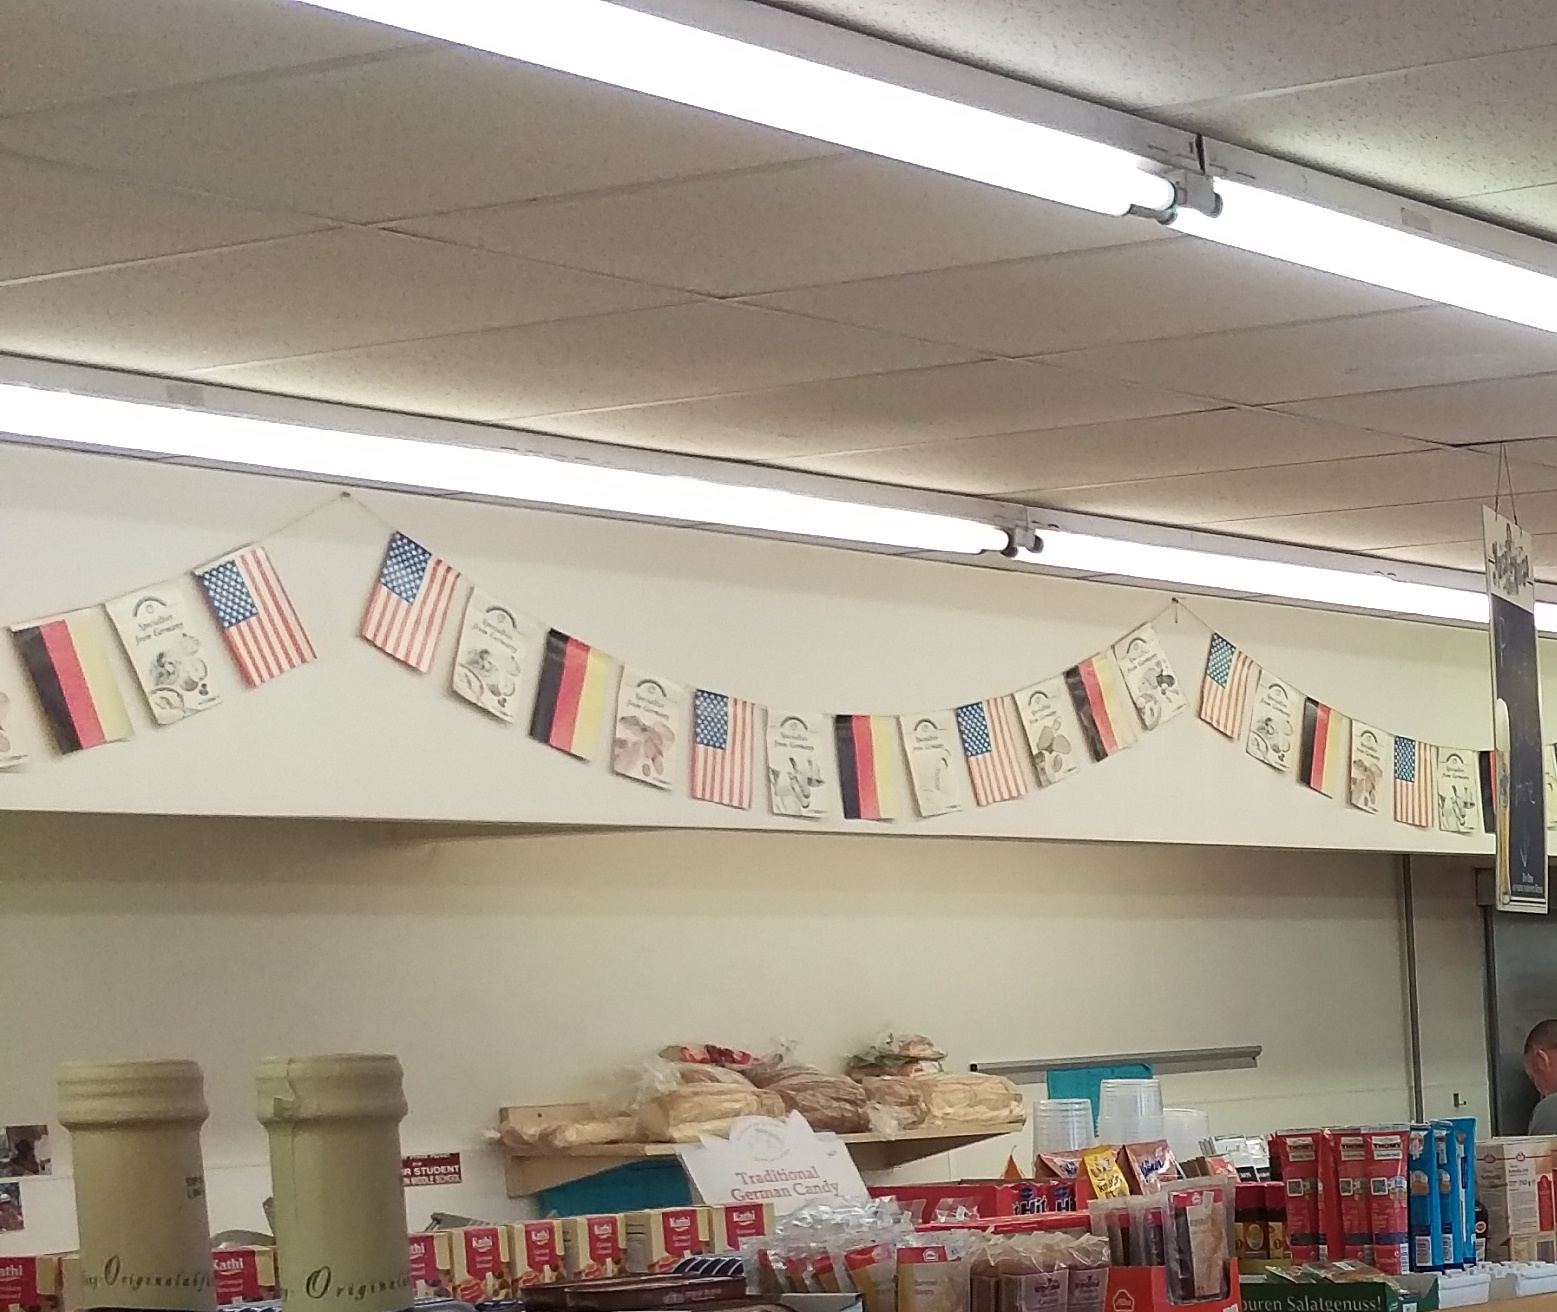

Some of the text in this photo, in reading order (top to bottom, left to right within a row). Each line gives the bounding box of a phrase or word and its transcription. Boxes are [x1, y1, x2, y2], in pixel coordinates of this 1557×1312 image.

[415, 1165, 460, 1177] STUDENT
[735, 1165, 821, 1186] Traditional
[731, 1179, 840, 1202] German Candy
[732, 1211, 757, 1223] Kathi
[472, 1236, 494, 1250] Kathi
[0, 1264, 23, 1277] athi
